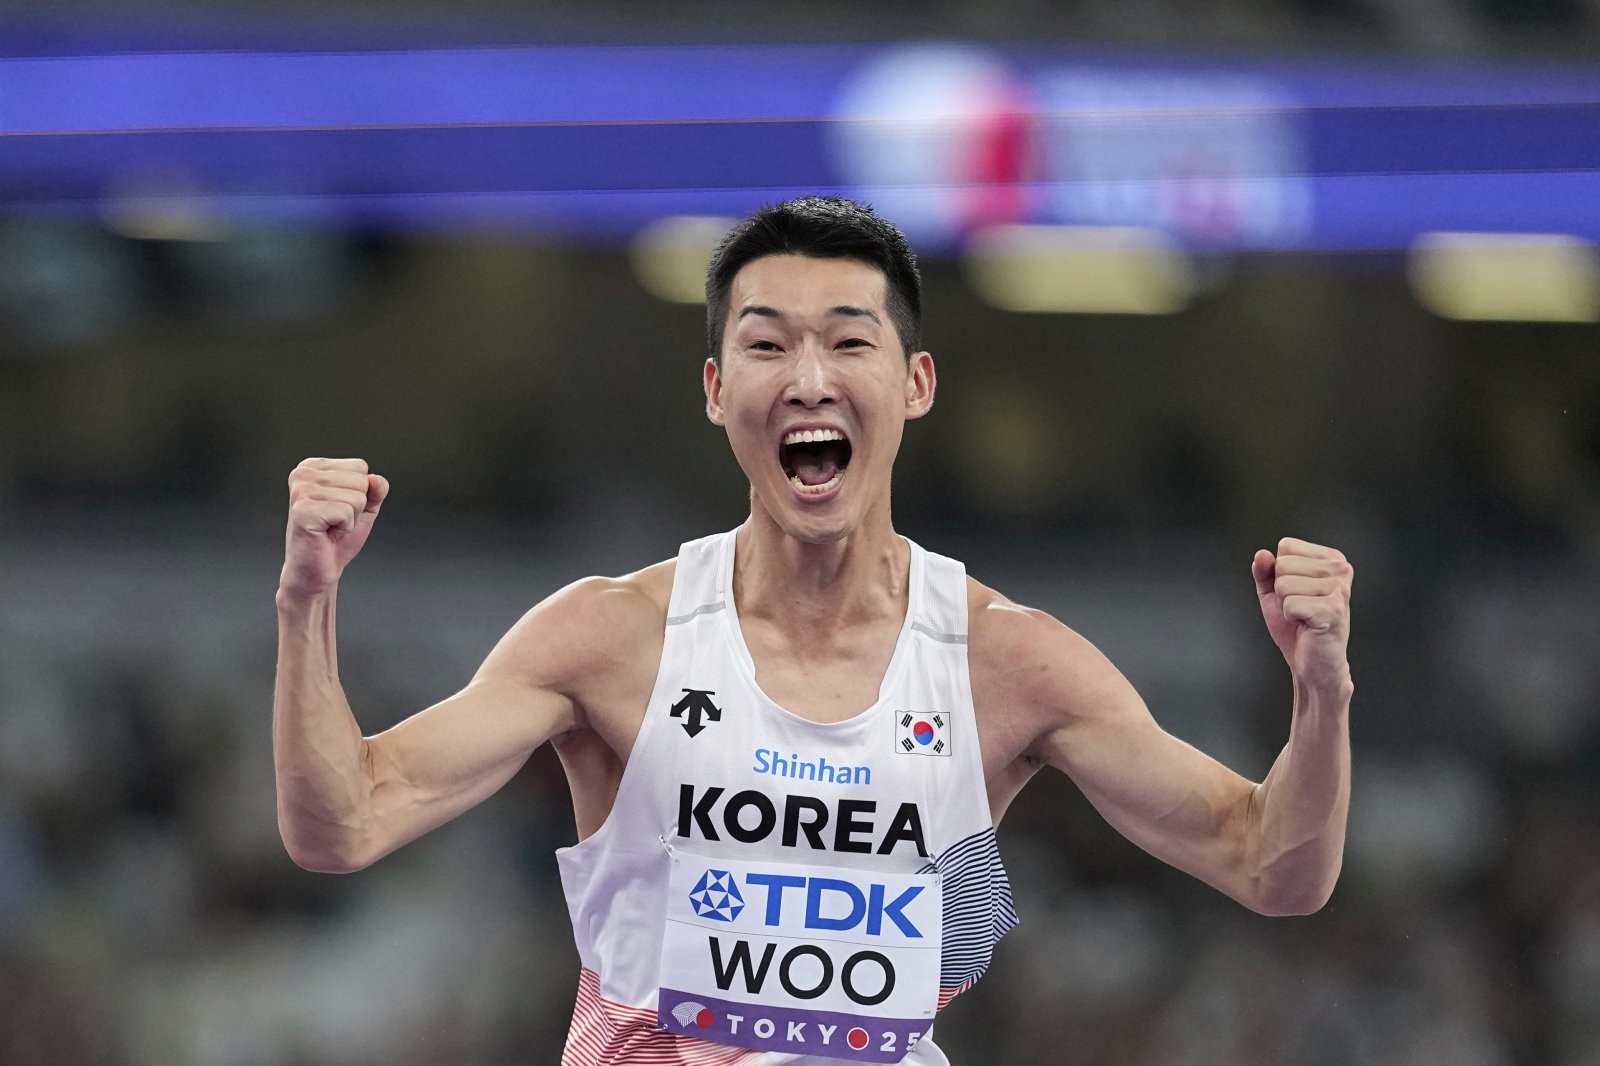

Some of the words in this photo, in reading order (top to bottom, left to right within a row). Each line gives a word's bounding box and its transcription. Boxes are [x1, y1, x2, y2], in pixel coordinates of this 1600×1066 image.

[753, 748, 871, 784] Shinhan
[677, 784, 930, 858] KOREA
[745, 872, 926, 938] TDK
[708, 936, 896, 1006] WOO
